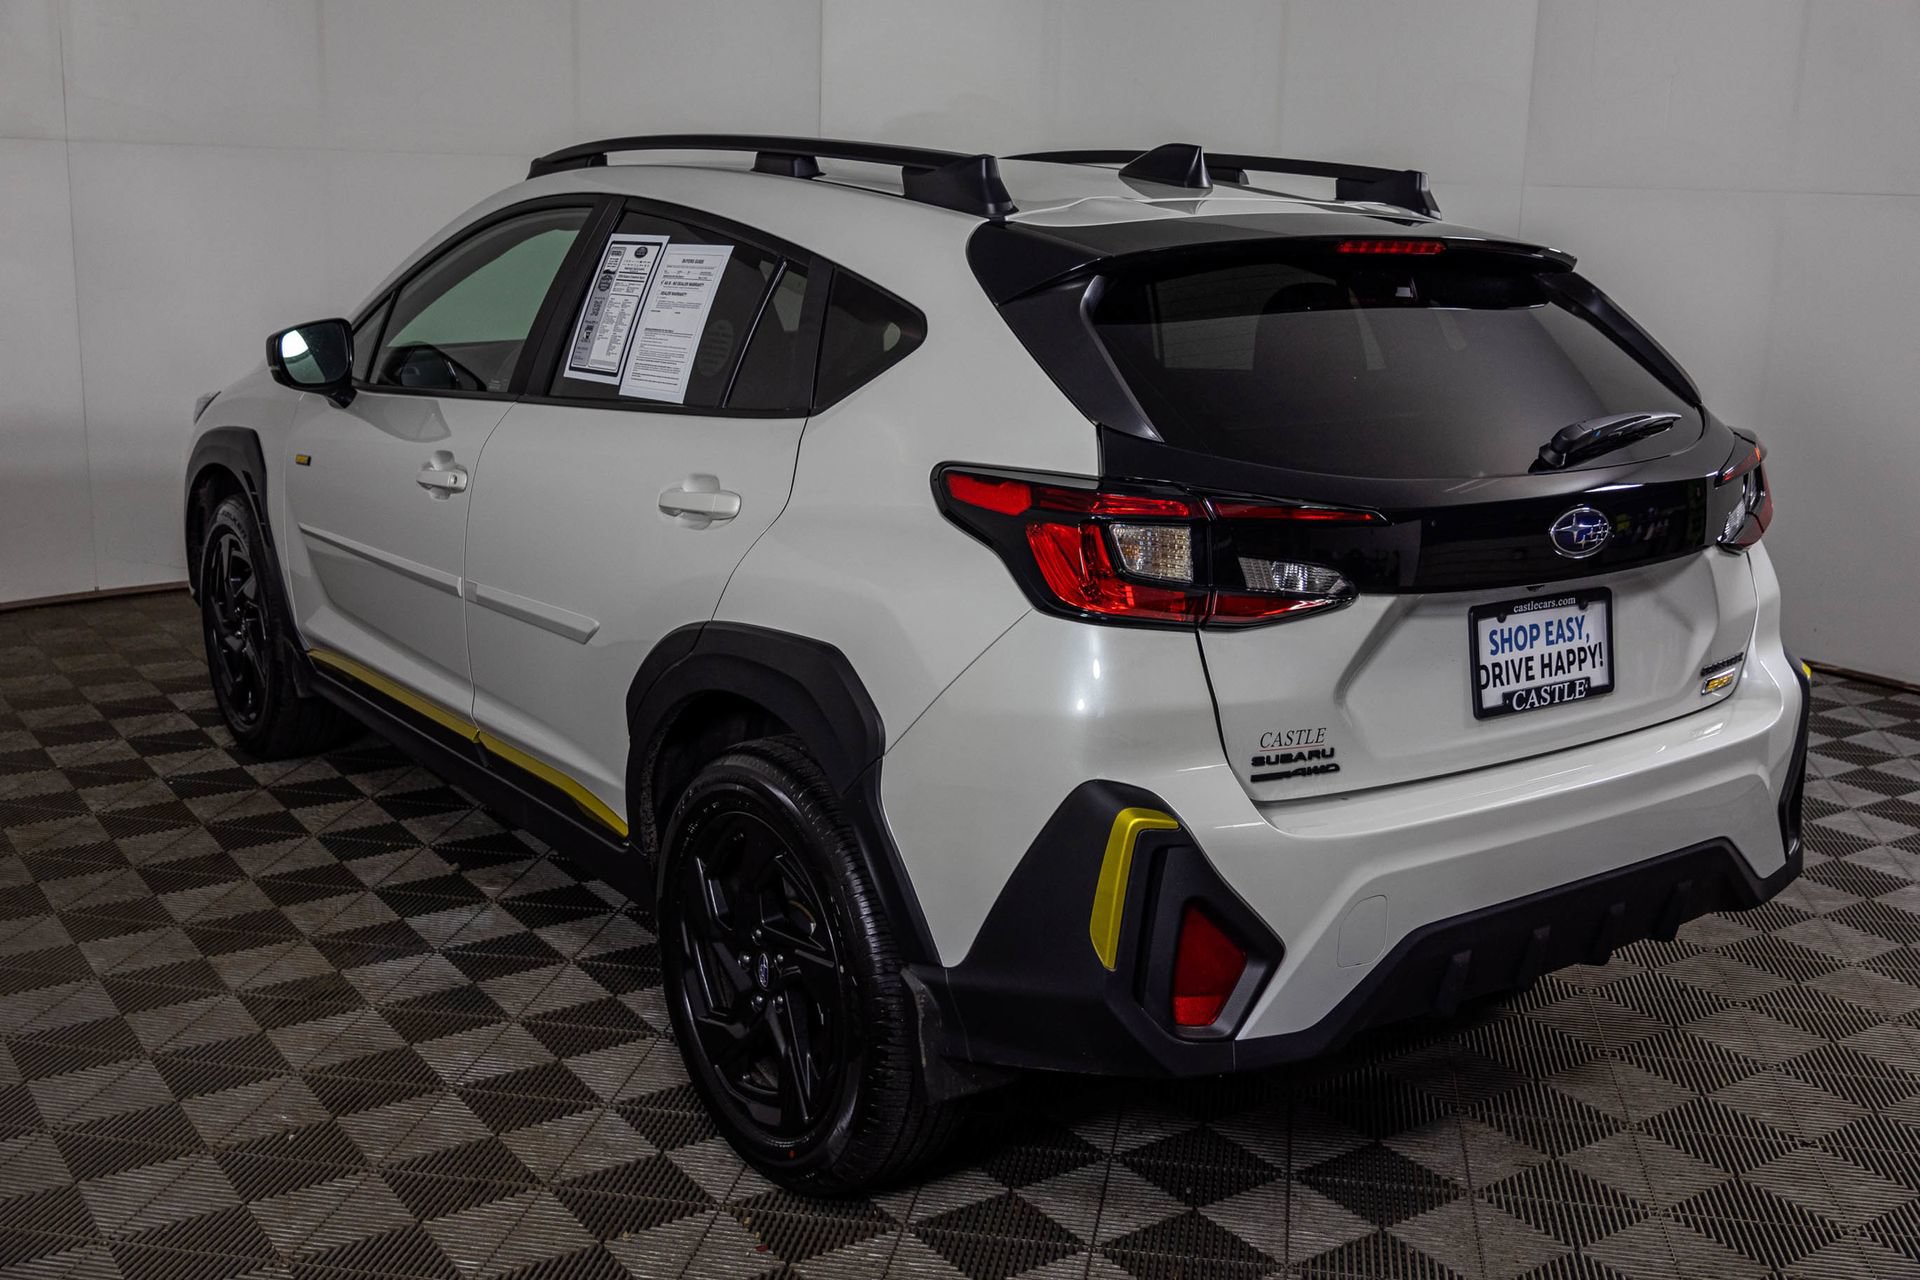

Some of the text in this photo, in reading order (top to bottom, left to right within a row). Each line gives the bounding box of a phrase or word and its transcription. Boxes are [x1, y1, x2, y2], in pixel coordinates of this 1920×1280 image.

[1513, 596, 1576, 613] castlecars.com
[1489, 614, 1590, 656] SHOP EASY,
[1480, 641, 1604, 690] DRIVE HAPPY!
[1512, 680, 1587, 711] CASTLE
[1260, 727, 1327, 749] CASTLE
[1251, 747, 1335, 767] SUBARU
